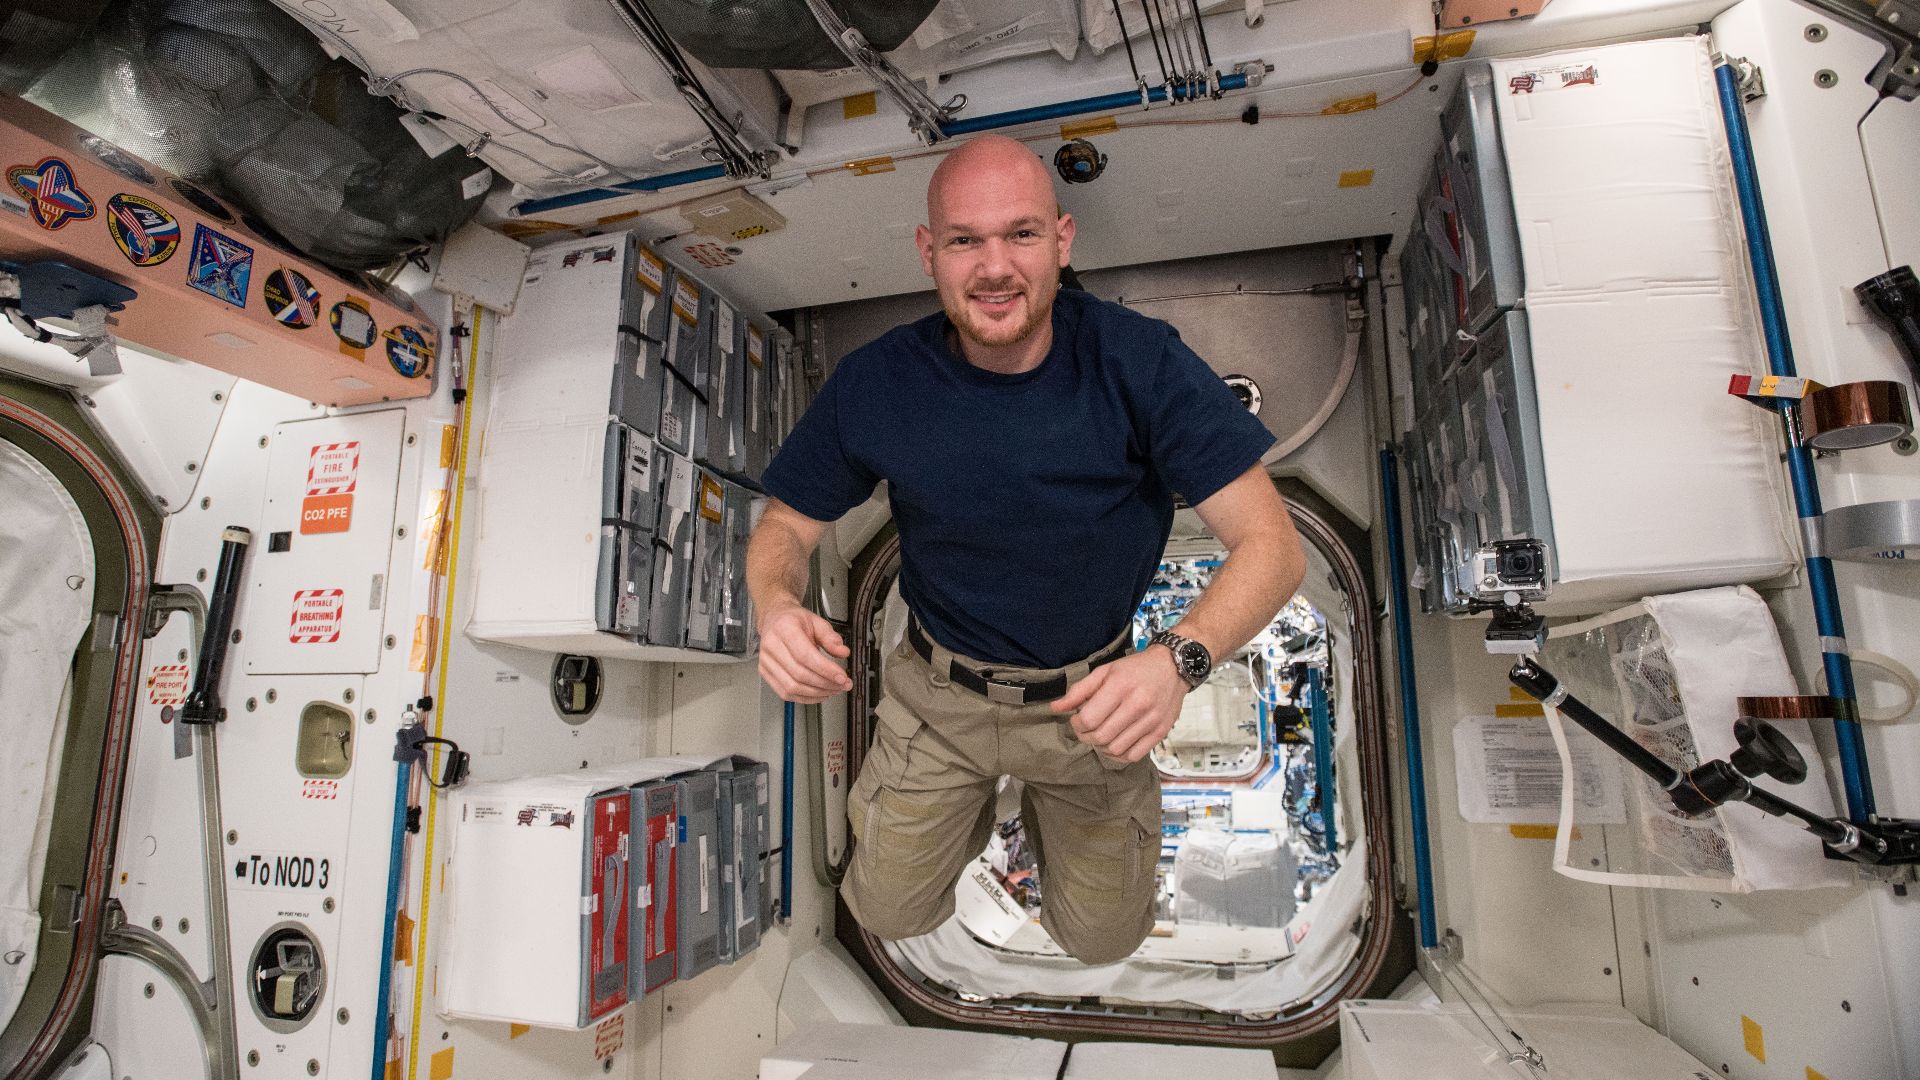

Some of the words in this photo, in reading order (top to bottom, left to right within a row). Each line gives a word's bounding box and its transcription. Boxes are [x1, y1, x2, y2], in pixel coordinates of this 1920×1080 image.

[320, 452, 349, 461] PORTABLE
[323, 463, 343, 473] FIRE
[304, 509, 325, 521] CO2
[327, 507, 348, 519] PFE
[303, 599, 333, 607] PORTABLE
[299, 611, 334, 621] BREATHING
[298, 625, 332, 633] APPARATUS
[250, 854, 271, 886] To
[274, 856, 315, 888] NOD
[318, 858, 329, 890] 3
